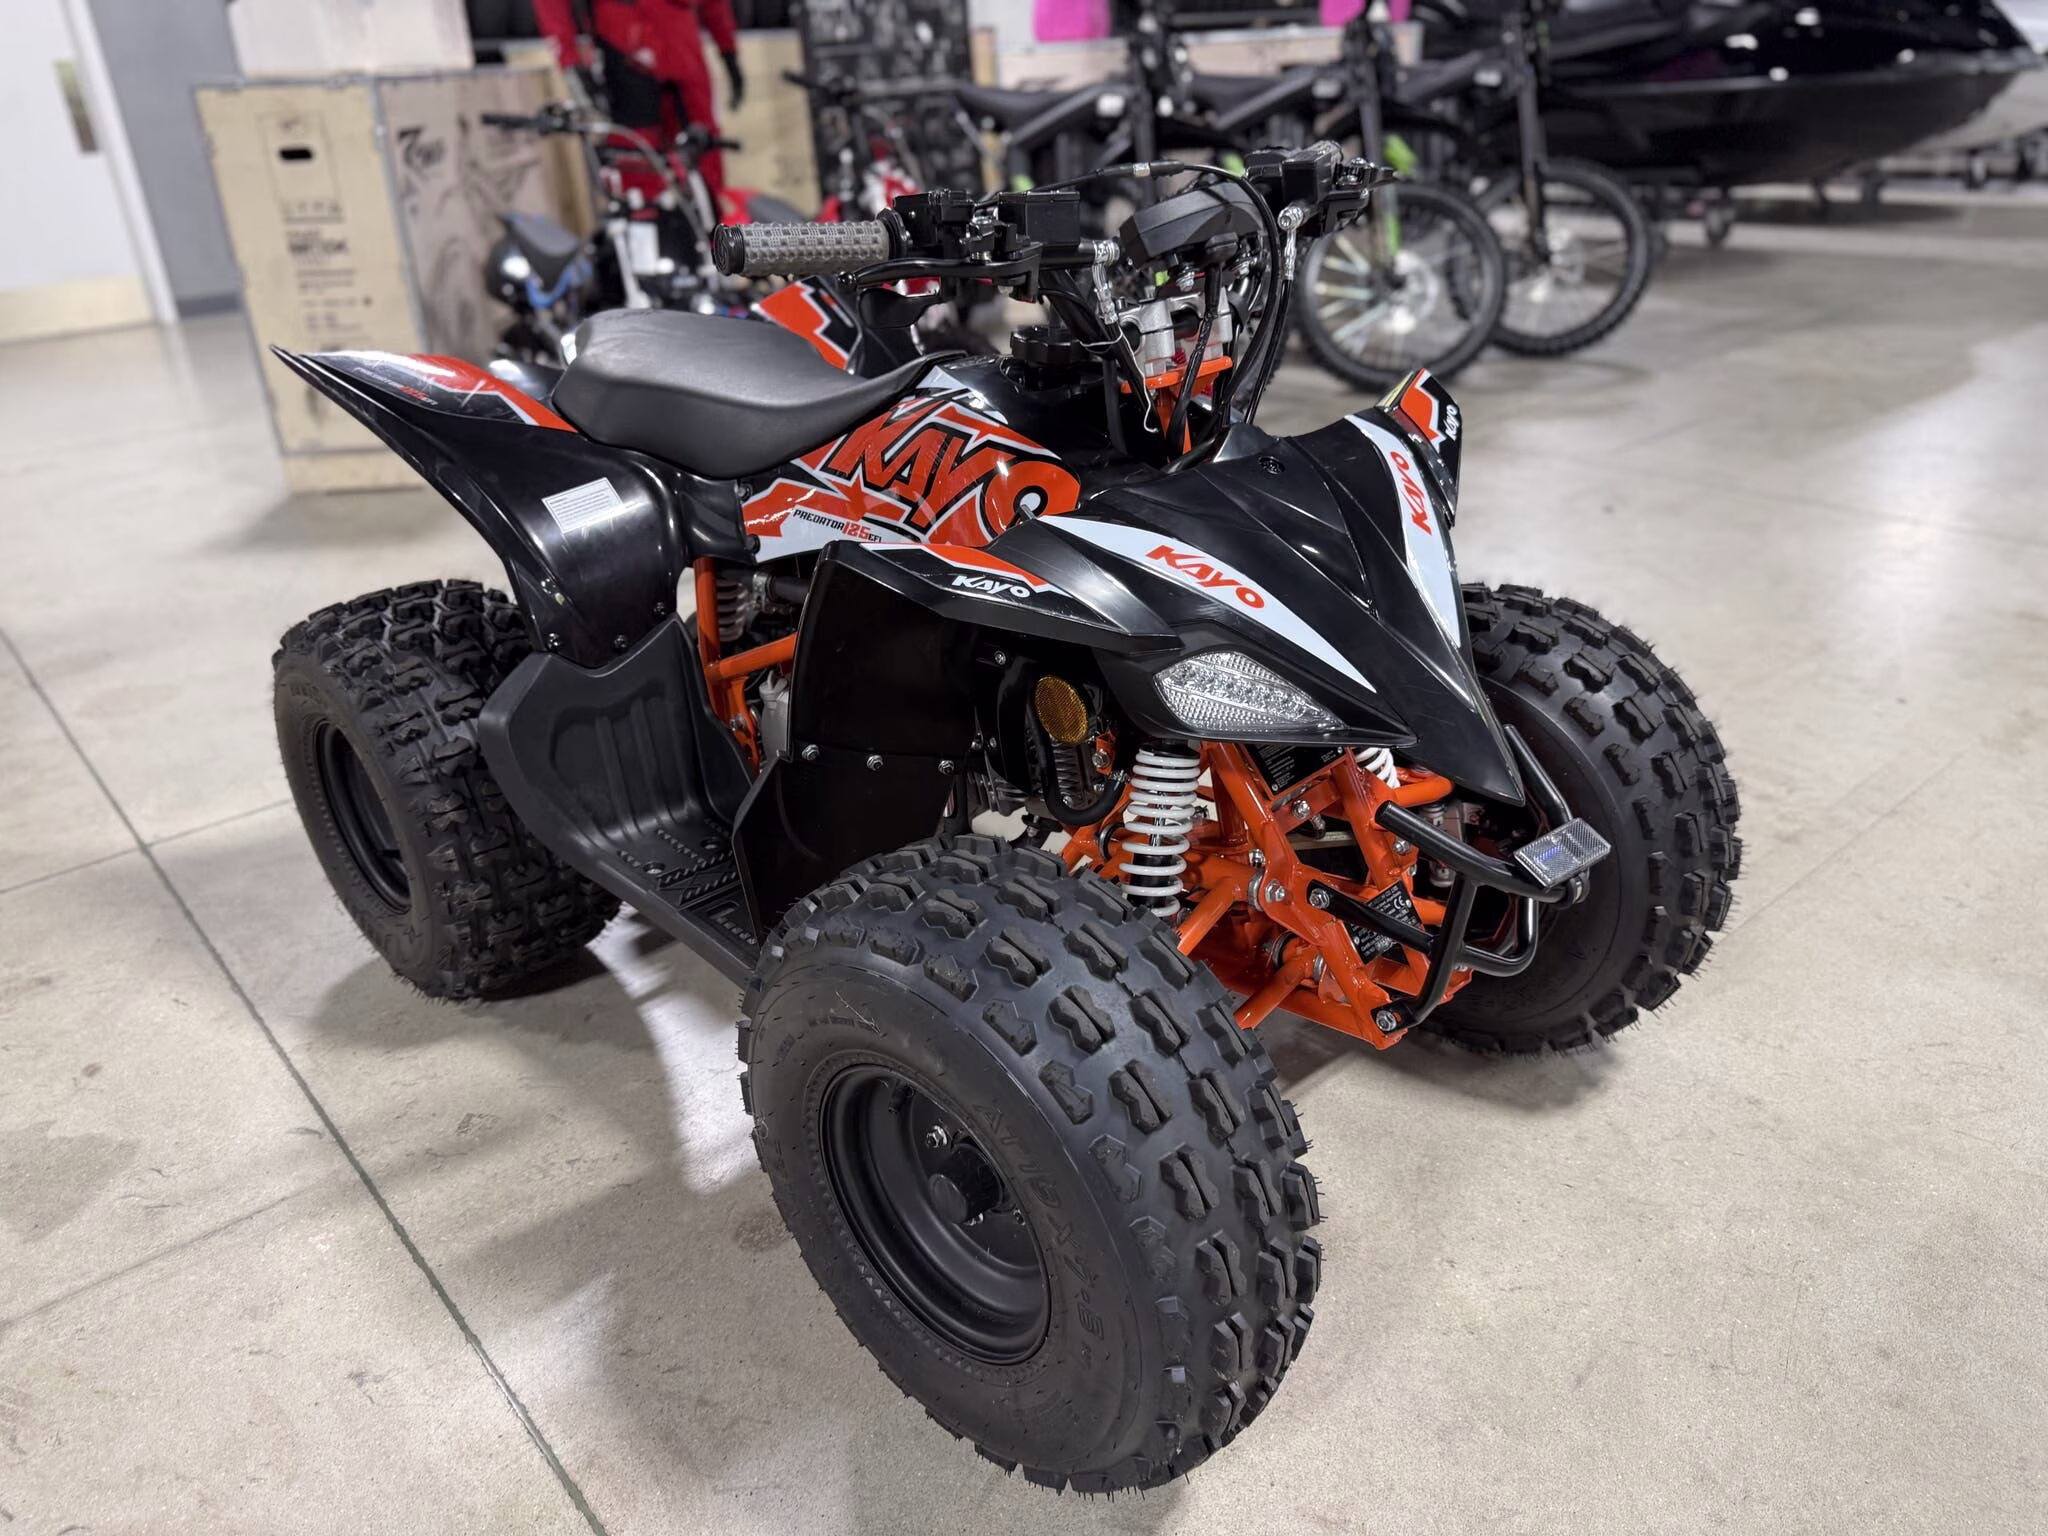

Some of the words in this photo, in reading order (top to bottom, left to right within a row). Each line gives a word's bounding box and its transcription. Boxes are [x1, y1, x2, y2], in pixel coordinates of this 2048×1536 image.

[1445, 404, 1459, 442] KAYO
[820, 396, 1081, 536] KAYO
[1390, 451, 1433, 536] KAYO
[952, 574, 1030, 598] KAYO
[1146, 544, 1265, 609] KAYO
